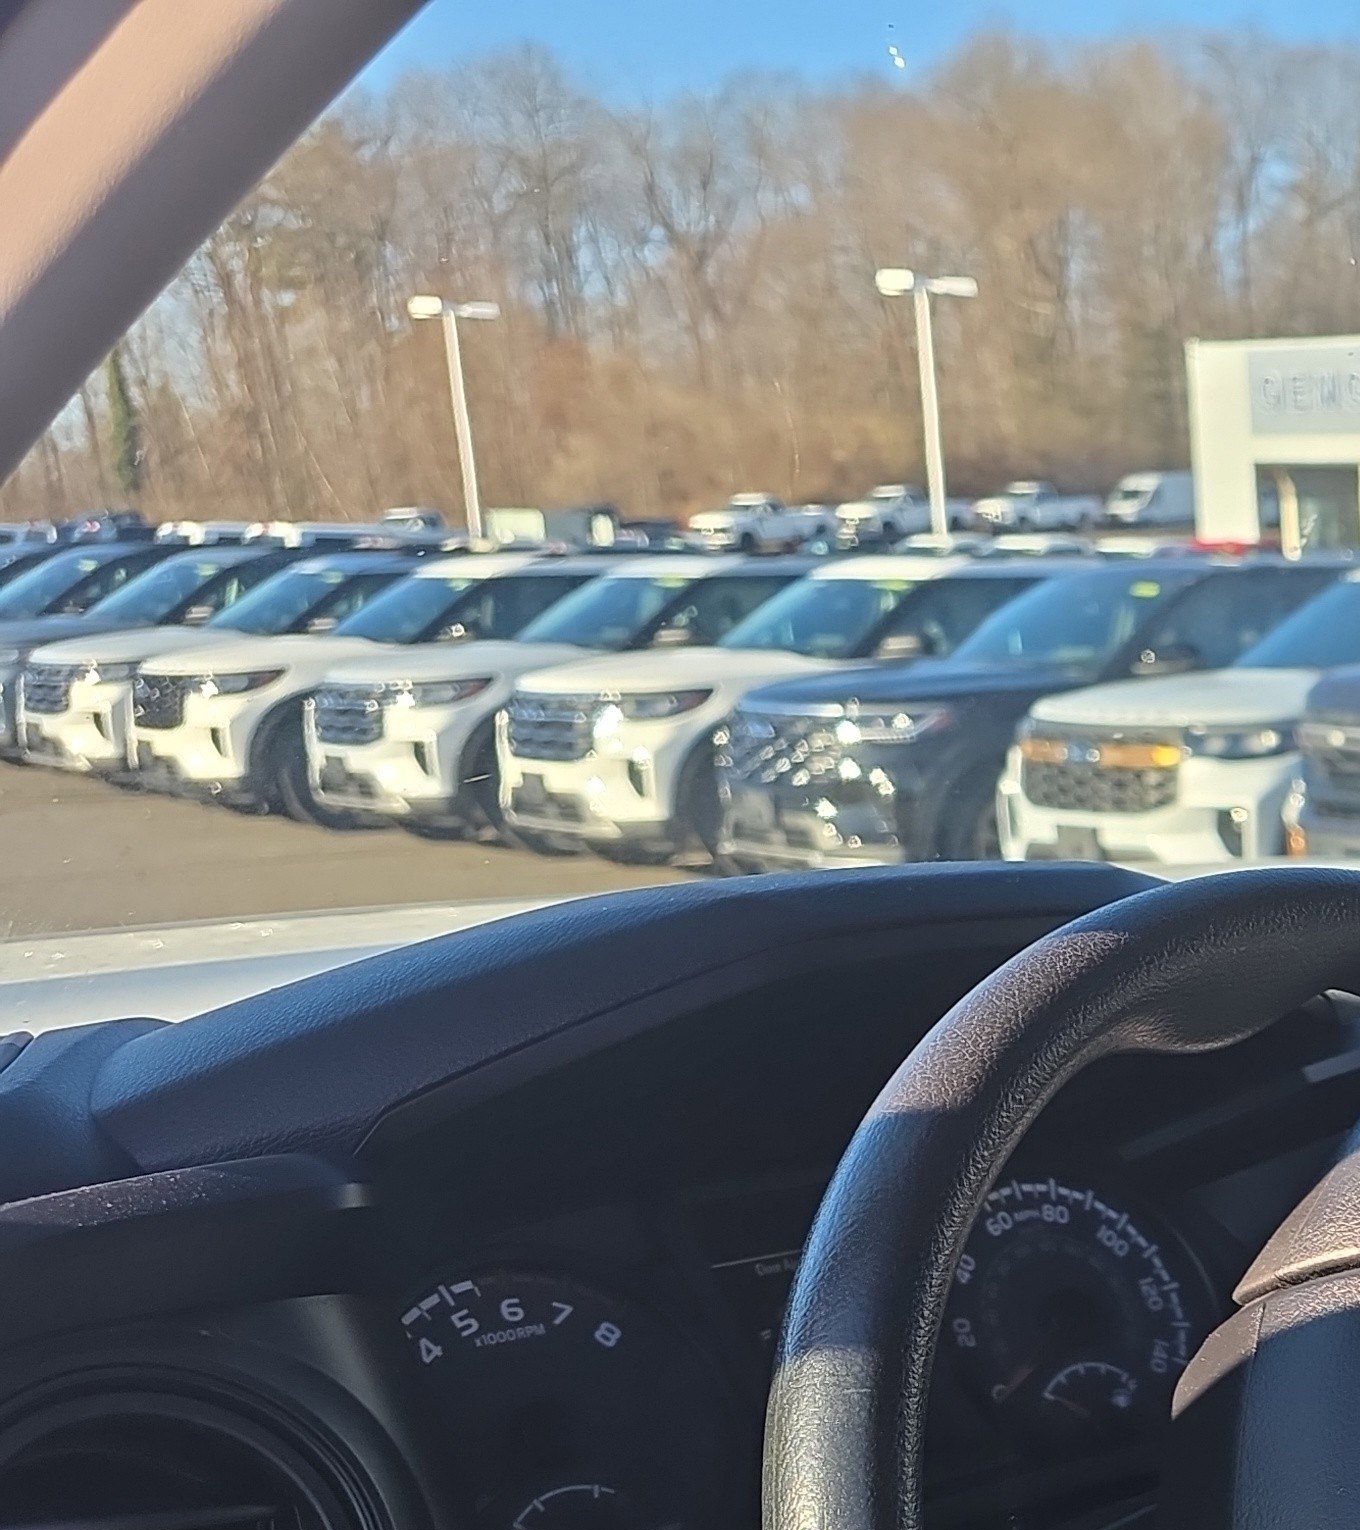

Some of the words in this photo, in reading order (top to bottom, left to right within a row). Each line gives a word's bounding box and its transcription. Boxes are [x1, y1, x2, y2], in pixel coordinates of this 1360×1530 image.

[985, 1211, 1013, 1236] 60
[1041, 1204, 1070, 1224] 80
[500, 1298, 525, 1322] 6
[552, 1301, 574, 1325] 7
[451, 1309, 479, 1337] 5
[594, 1321, 622, 1347] 8
[419, 1337, 443, 1364] 4
